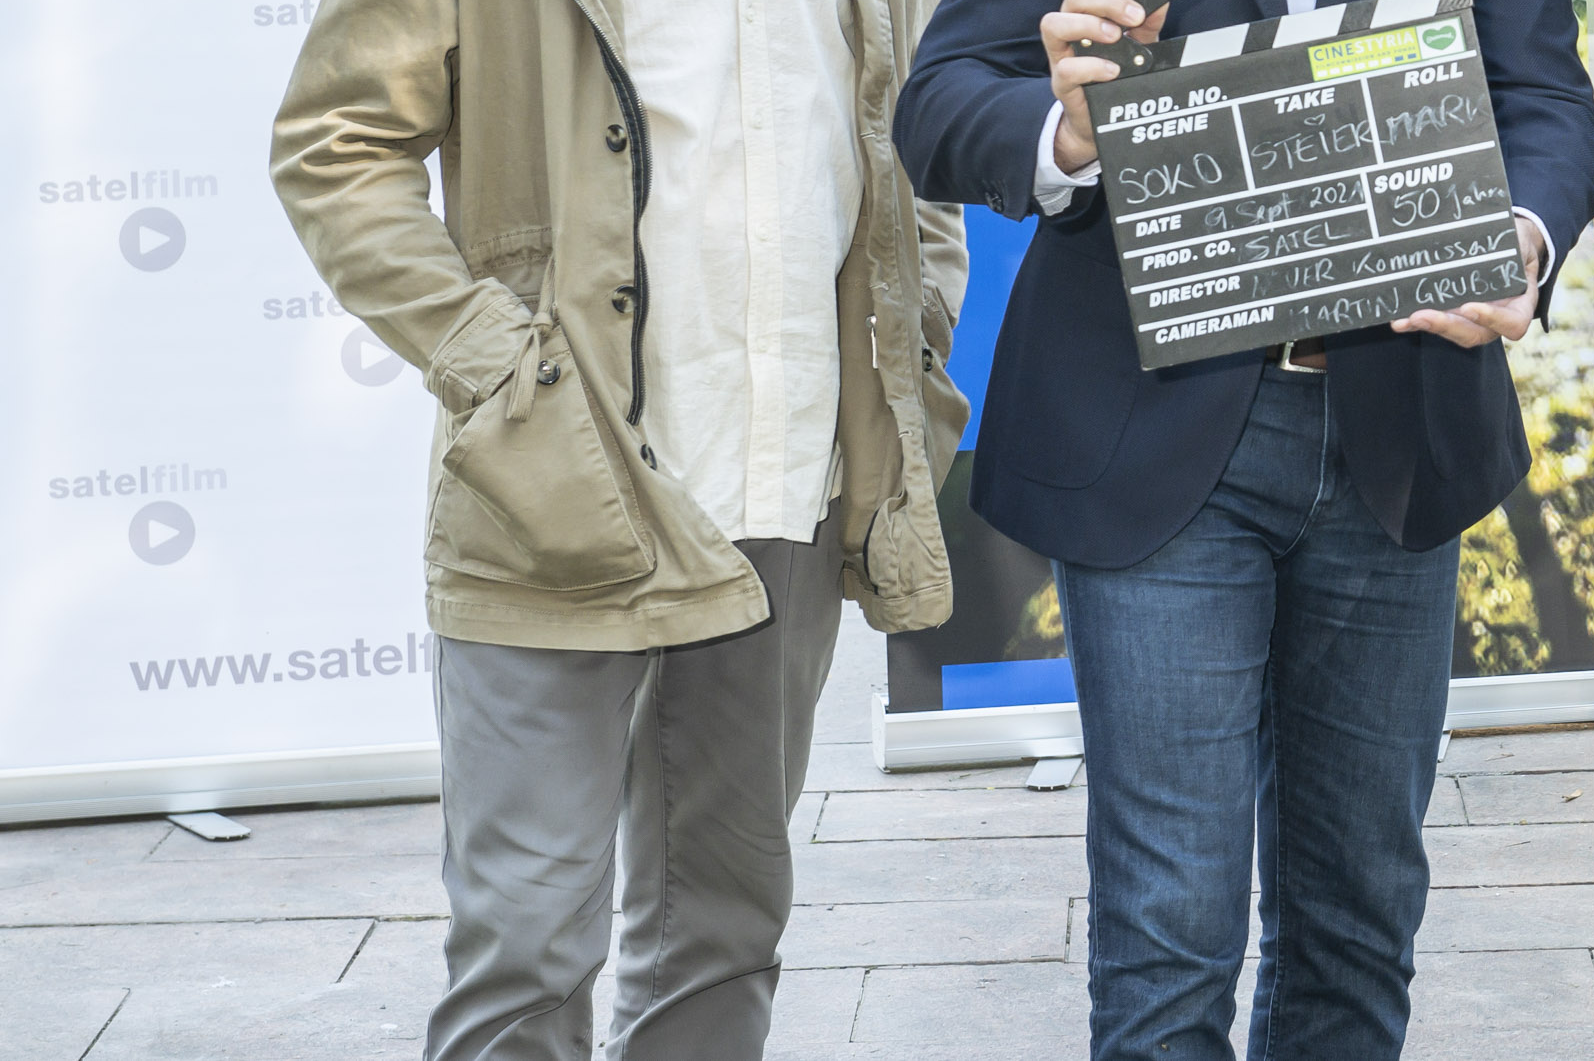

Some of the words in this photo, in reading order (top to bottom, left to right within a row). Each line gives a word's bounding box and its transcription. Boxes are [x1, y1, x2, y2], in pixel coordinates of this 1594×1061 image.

[1313, 29, 1415, 62] CINESTYRIA
[1403, 62, 1463, 88] ROLL
[1109, 96, 1179, 123] PROD.
[1188, 86, 1228, 108] NO.
[1274, 87, 1335, 114] TAKE
[1131, 113, 1208, 144] SCENE
[38, 170, 219, 204] satelfilm
[1118, 152, 1222, 204] SOKO
[1374, 162, 1454, 194] SOUND
[1391, 187, 1440, 227] 50
[1135, 214, 1182, 237] DATE
[1244, 221, 1350, 261] SATEL
[1142, 248, 1198, 271] PROD.
[1204, 240, 1236, 258] CO.
[1149, 275, 1241, 307] DIRECTOR
[1155, 305, 1275, 344] CAMERAMAN
[48, 463, 229, 500] satelfilm
